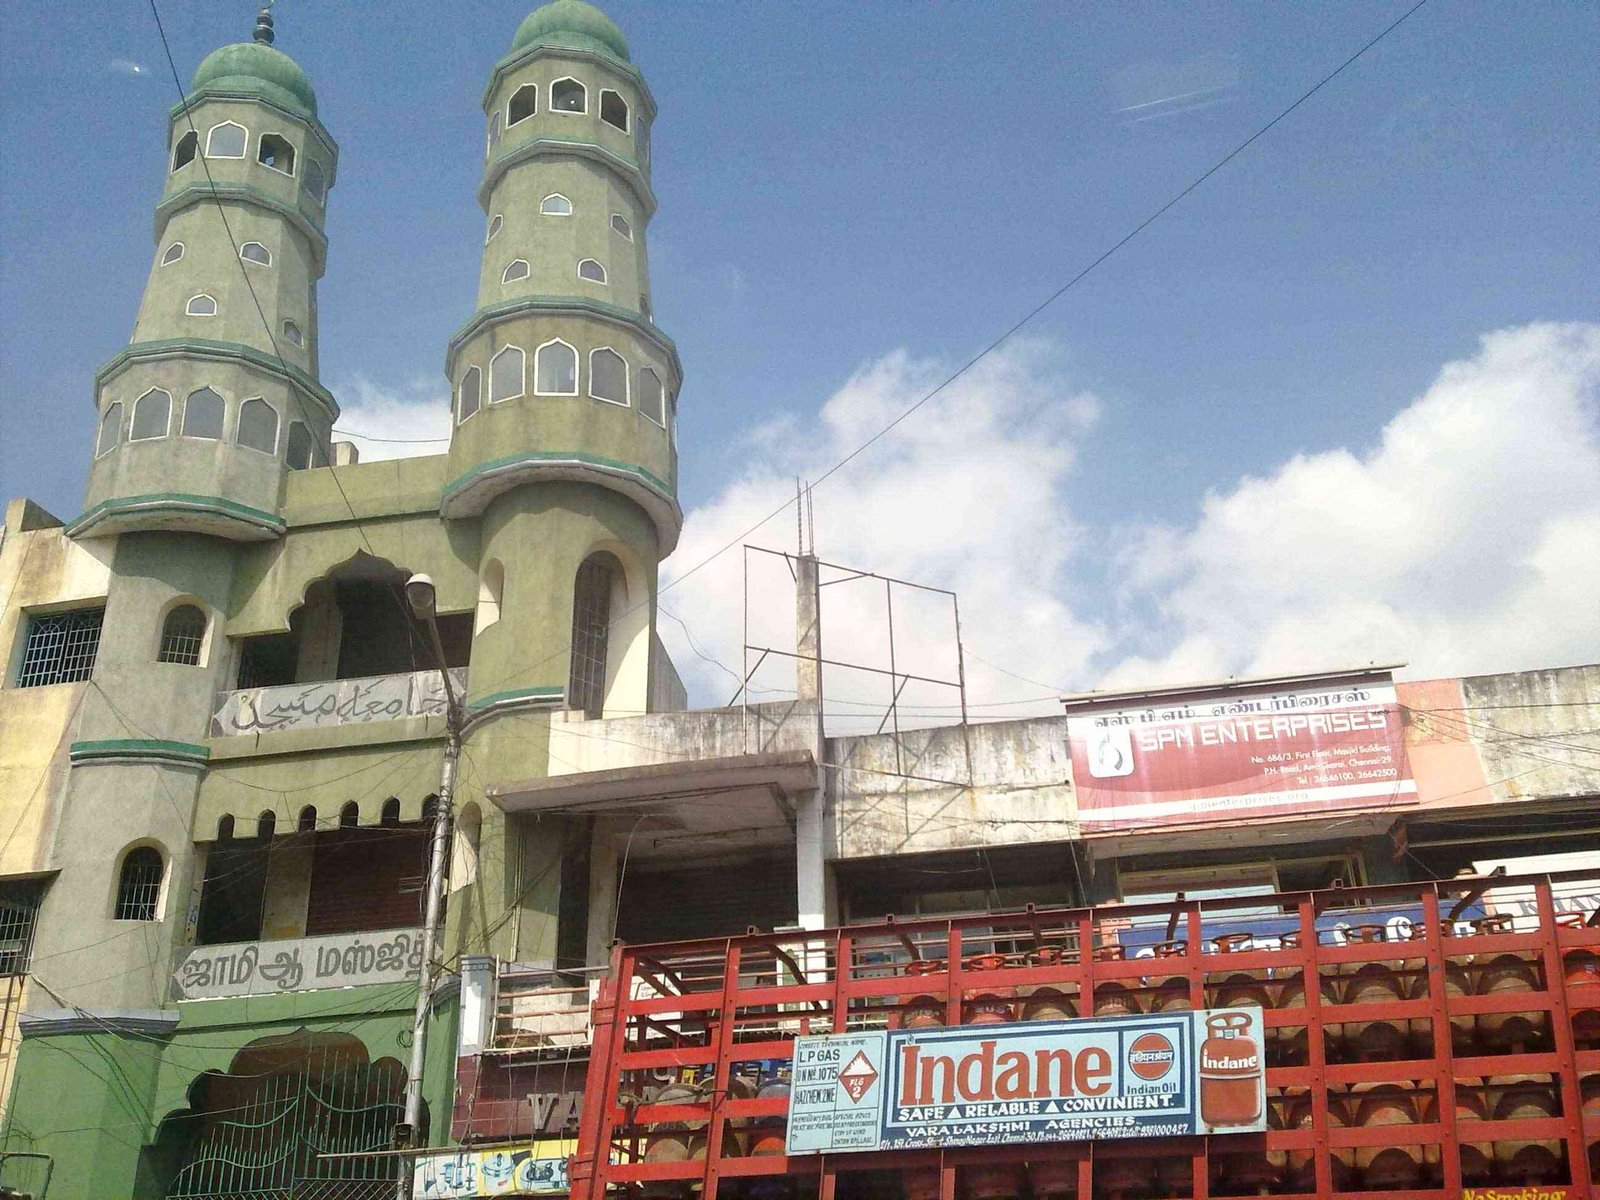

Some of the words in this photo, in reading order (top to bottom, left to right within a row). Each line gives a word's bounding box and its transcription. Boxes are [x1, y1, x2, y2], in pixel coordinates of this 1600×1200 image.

[1140, 725, 1195, 752] SPM
[1200, 710, 1388, 746] ENTERPRISES
[818, 1066, 838, 1081] 1075
[900, 1041, 1113, 1106] Indane
[853, 1086, 862, 1098] 2
[898, 1107, 945, 1121] SAFE
[965, 1101, 1040, 1118] RELABLE
